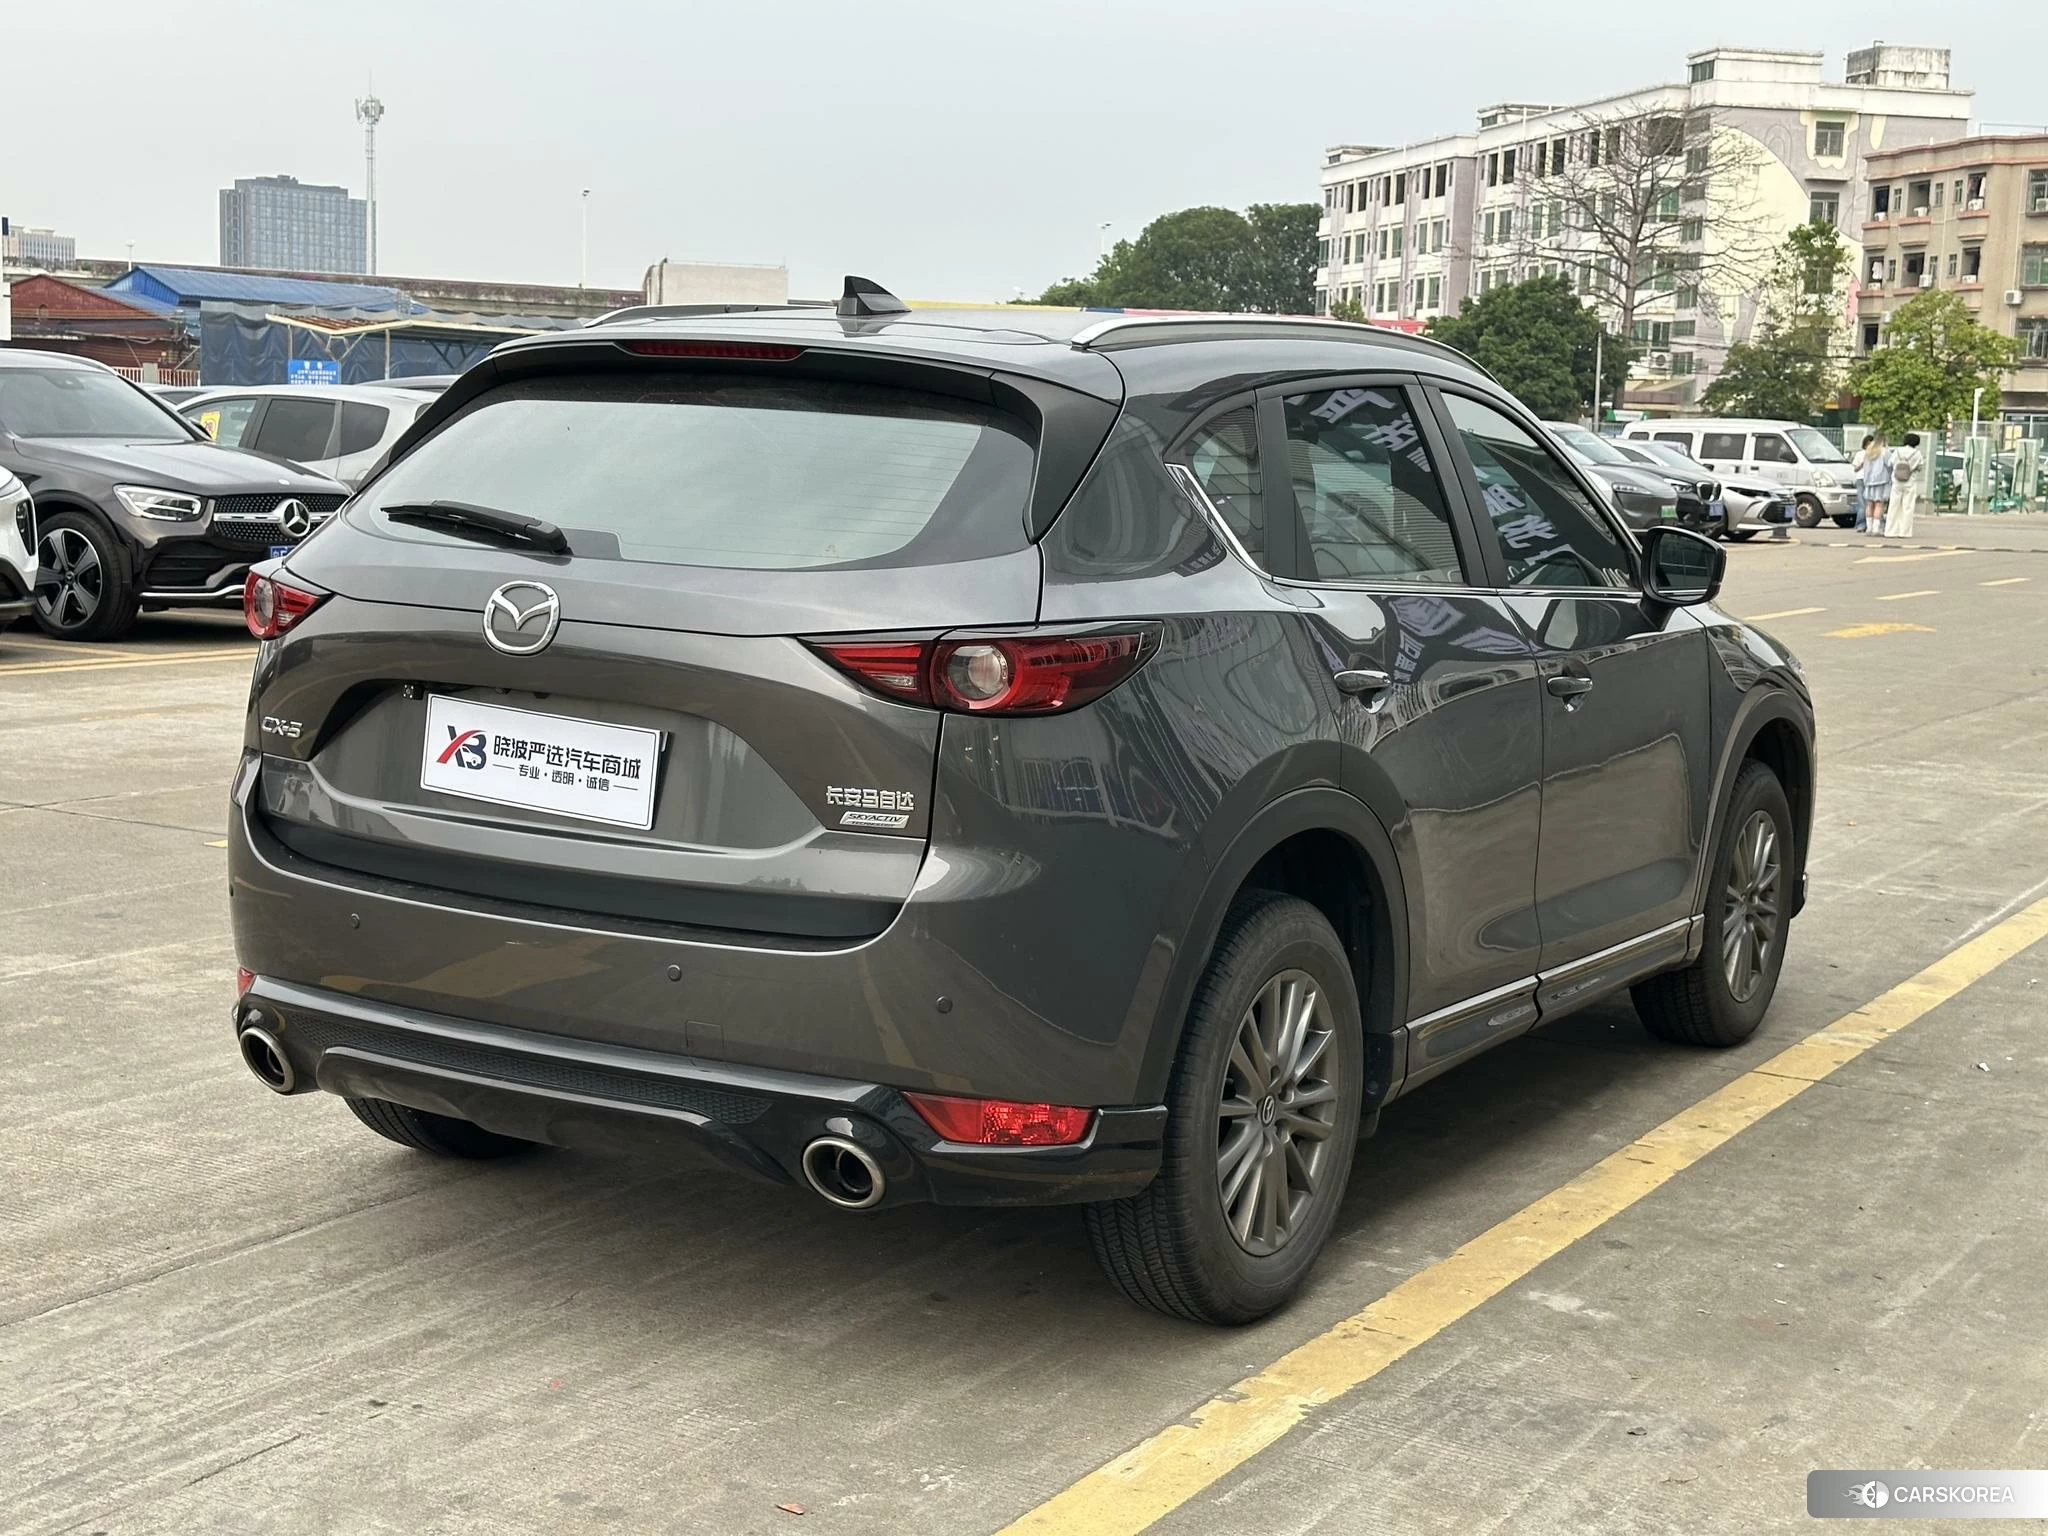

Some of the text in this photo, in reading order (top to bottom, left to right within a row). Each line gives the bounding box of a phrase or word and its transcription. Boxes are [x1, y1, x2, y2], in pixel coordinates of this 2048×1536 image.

[493, 735, 641, 779] 晓波严选汽车商城
[826, 785, 915, 811] 长安马自达
[847, 813, 903, 822] SKYACTIV
